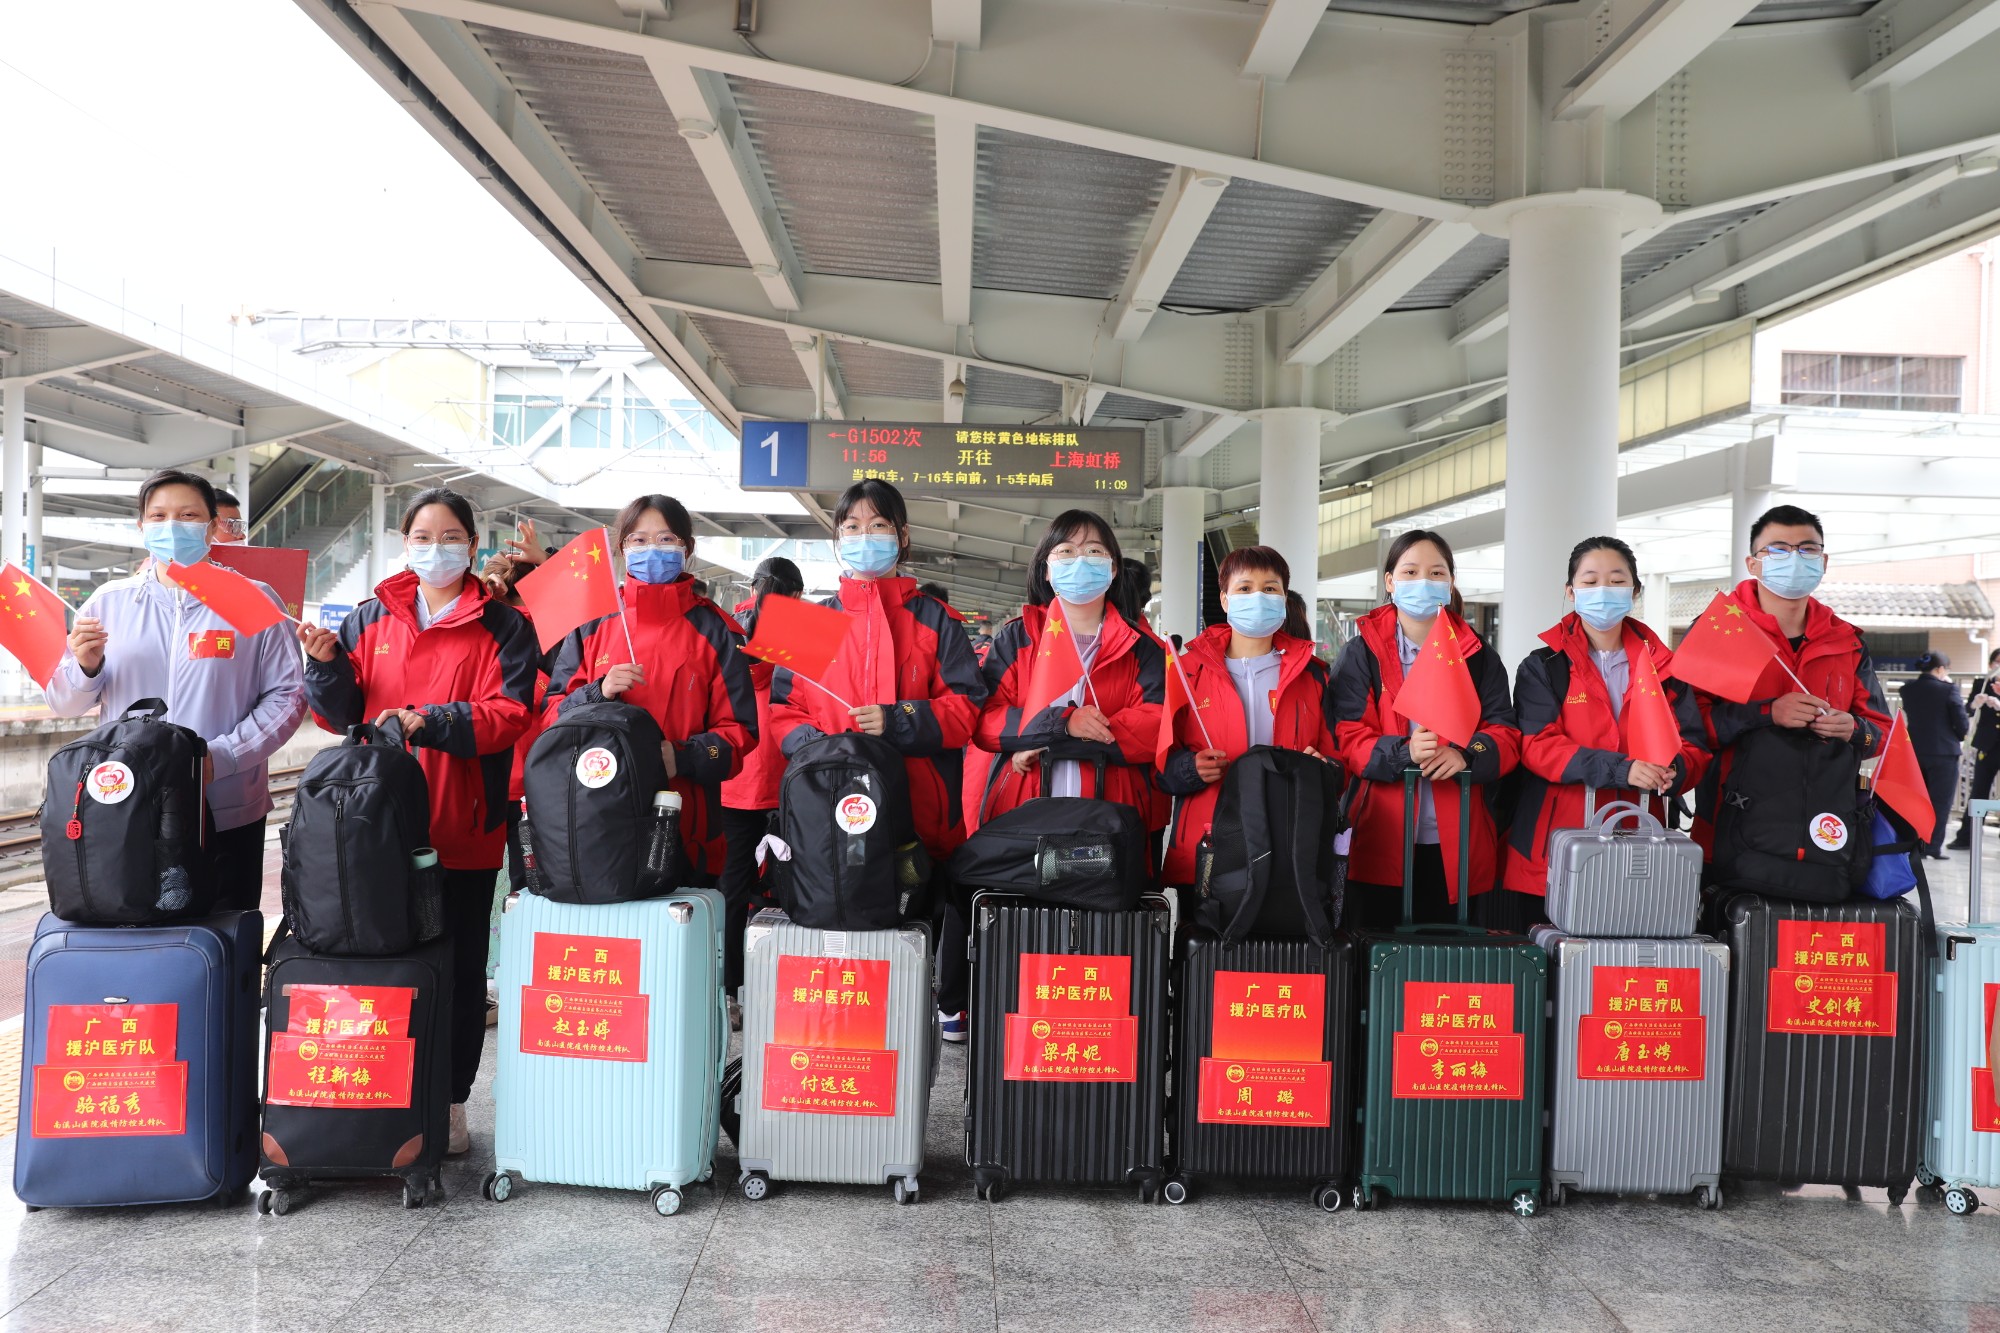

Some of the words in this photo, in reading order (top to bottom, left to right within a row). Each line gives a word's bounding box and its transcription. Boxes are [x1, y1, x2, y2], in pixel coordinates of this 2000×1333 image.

[847, 427, 922, 447] G1502次
[955, 430, 1079, 446] 请您按黄色地标排队
[760, 431, 779, 477] 1
[842, 448, 887, 463] 11:56
[957, 449, 993, 466] 开往
[1050, 451, 1121, 469] 上海虹桥
[1094, 479, 1128, 490] 11:09
[1795, 951, 1869, 967] 援沪医疗队
[548, 965, 622, 985] 援沪医疗队
[793, 988, 870, 1005] 援沪医疗队
[1036, 985, 1112, 1001] 援沪医疗队
[1230, 1002, 1307, 1019] 援沪医疗队
[1609, 997, 1683, 1012] 援沪医疗队
[1806, 996, 1862, 1018] 史剑锋
[306, 1018, 389, 1035] 援沪医疗队
[553, 1017, 610, 1040] 赵玉婷
[1421, 1013, 1496, 1028] 援沪医疗队
[66, 1039, 155, 1056] 援沪医疗队
[1042, 1042, 1101, 1062] 梁丹妮
[308, 1065, 371, 1087] 程新梅
[1432, 1059, 1488, 1079] 李丽梅
[801, 1075, 860, 1094] 付远远
